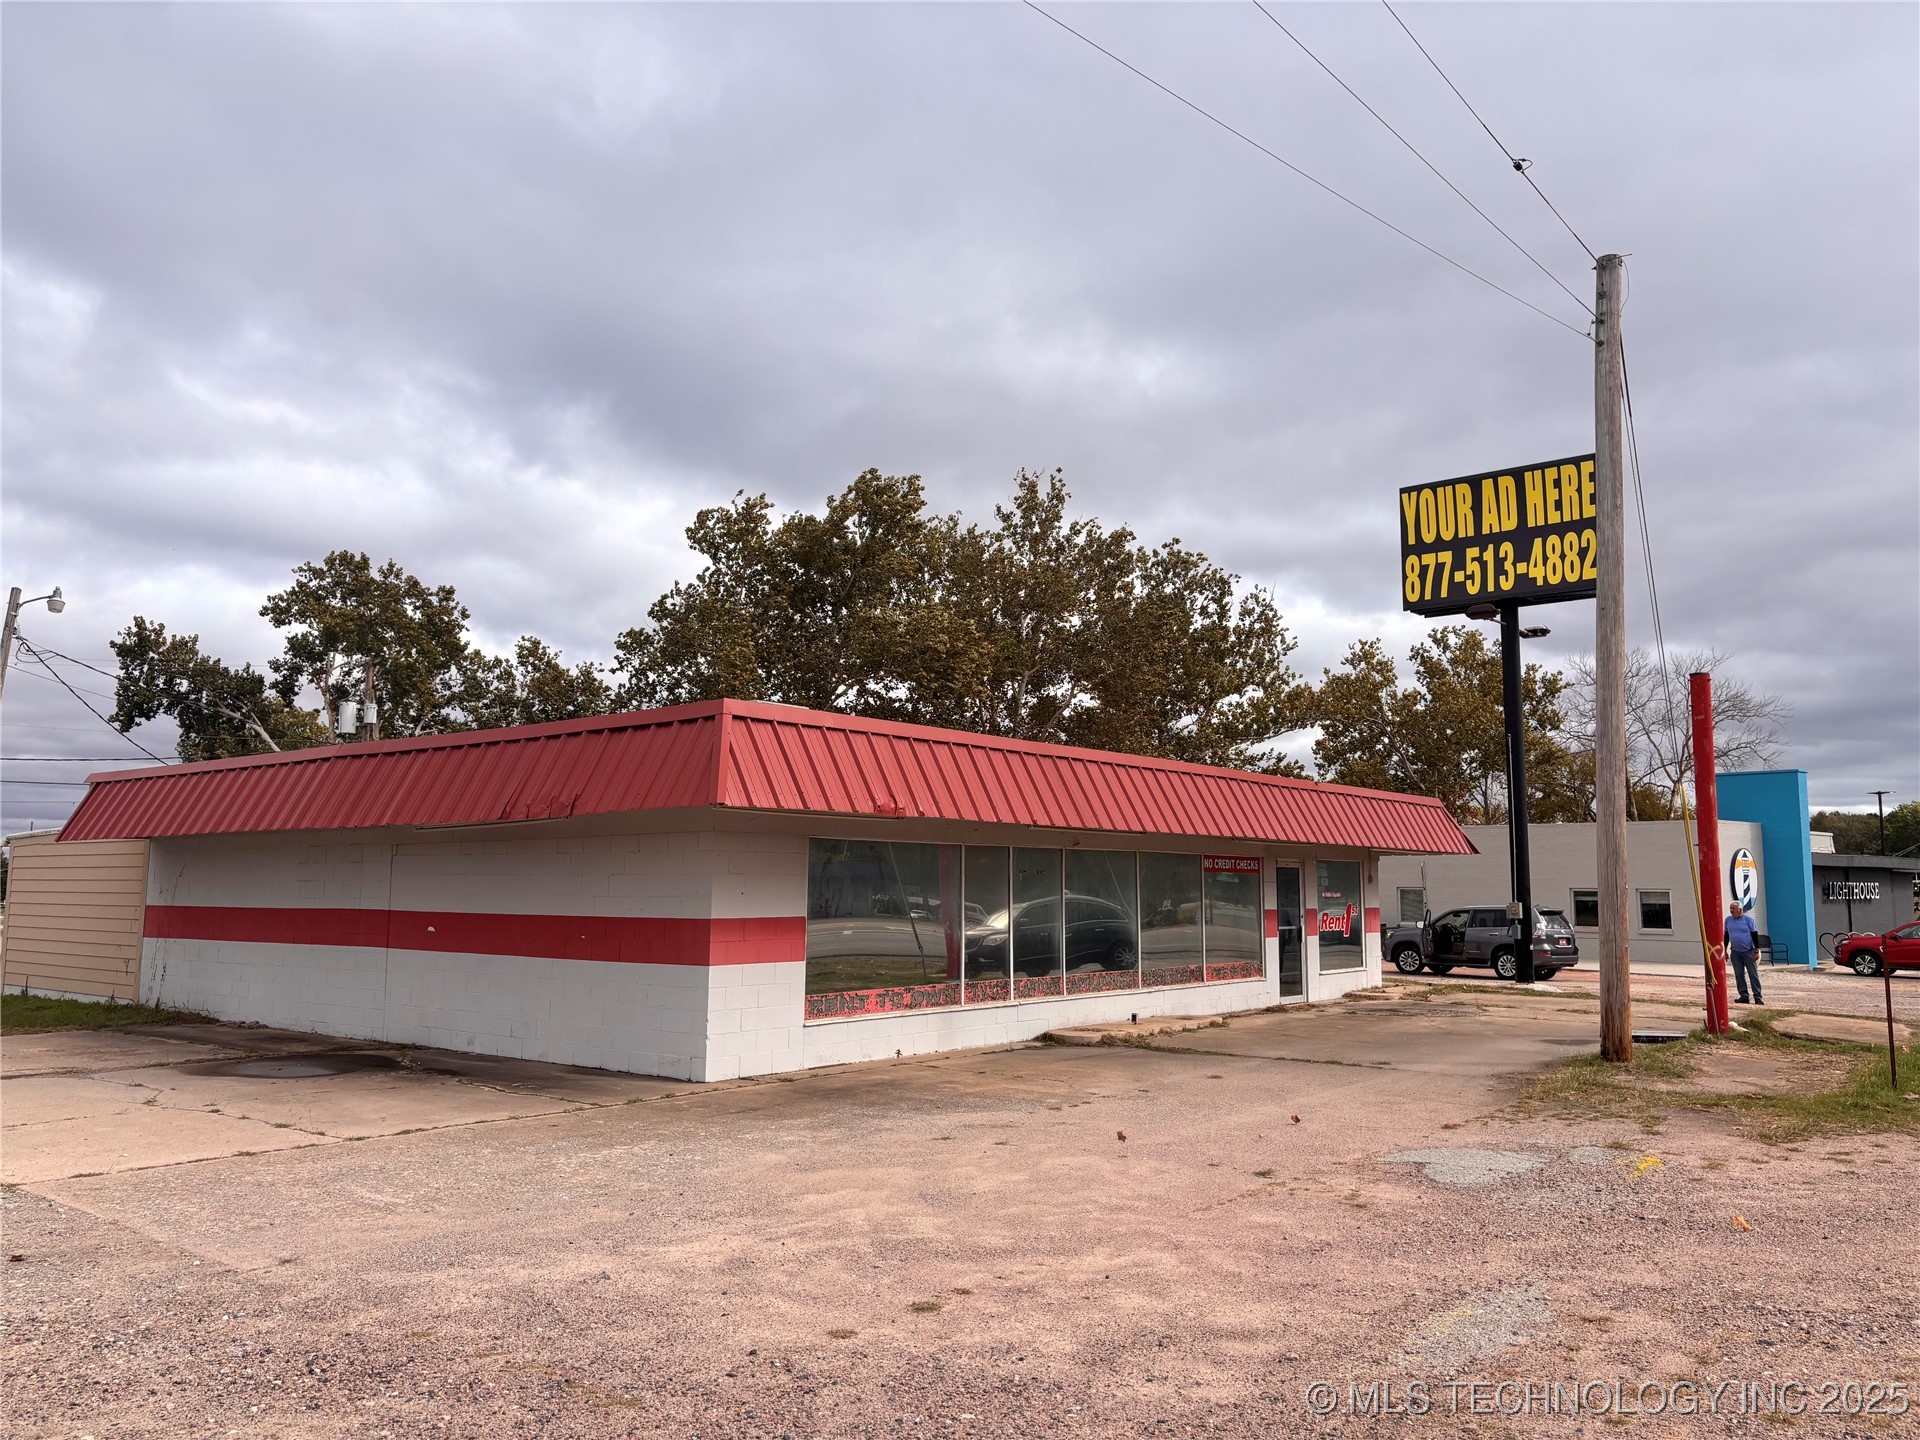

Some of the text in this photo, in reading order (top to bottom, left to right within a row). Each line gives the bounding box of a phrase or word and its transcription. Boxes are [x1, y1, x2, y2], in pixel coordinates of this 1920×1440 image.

[1401, 459, 1596, 546] YOUR AD HERE
[1404, 528, 1597, 603] 877-513-4882
[1204, 858, 1259, 870] NO CREDIT CHECKS
[1829, 882, 1880, 899] LIGHTHOUSE
[808, 987, 956, 1015] RENT TO OWN
